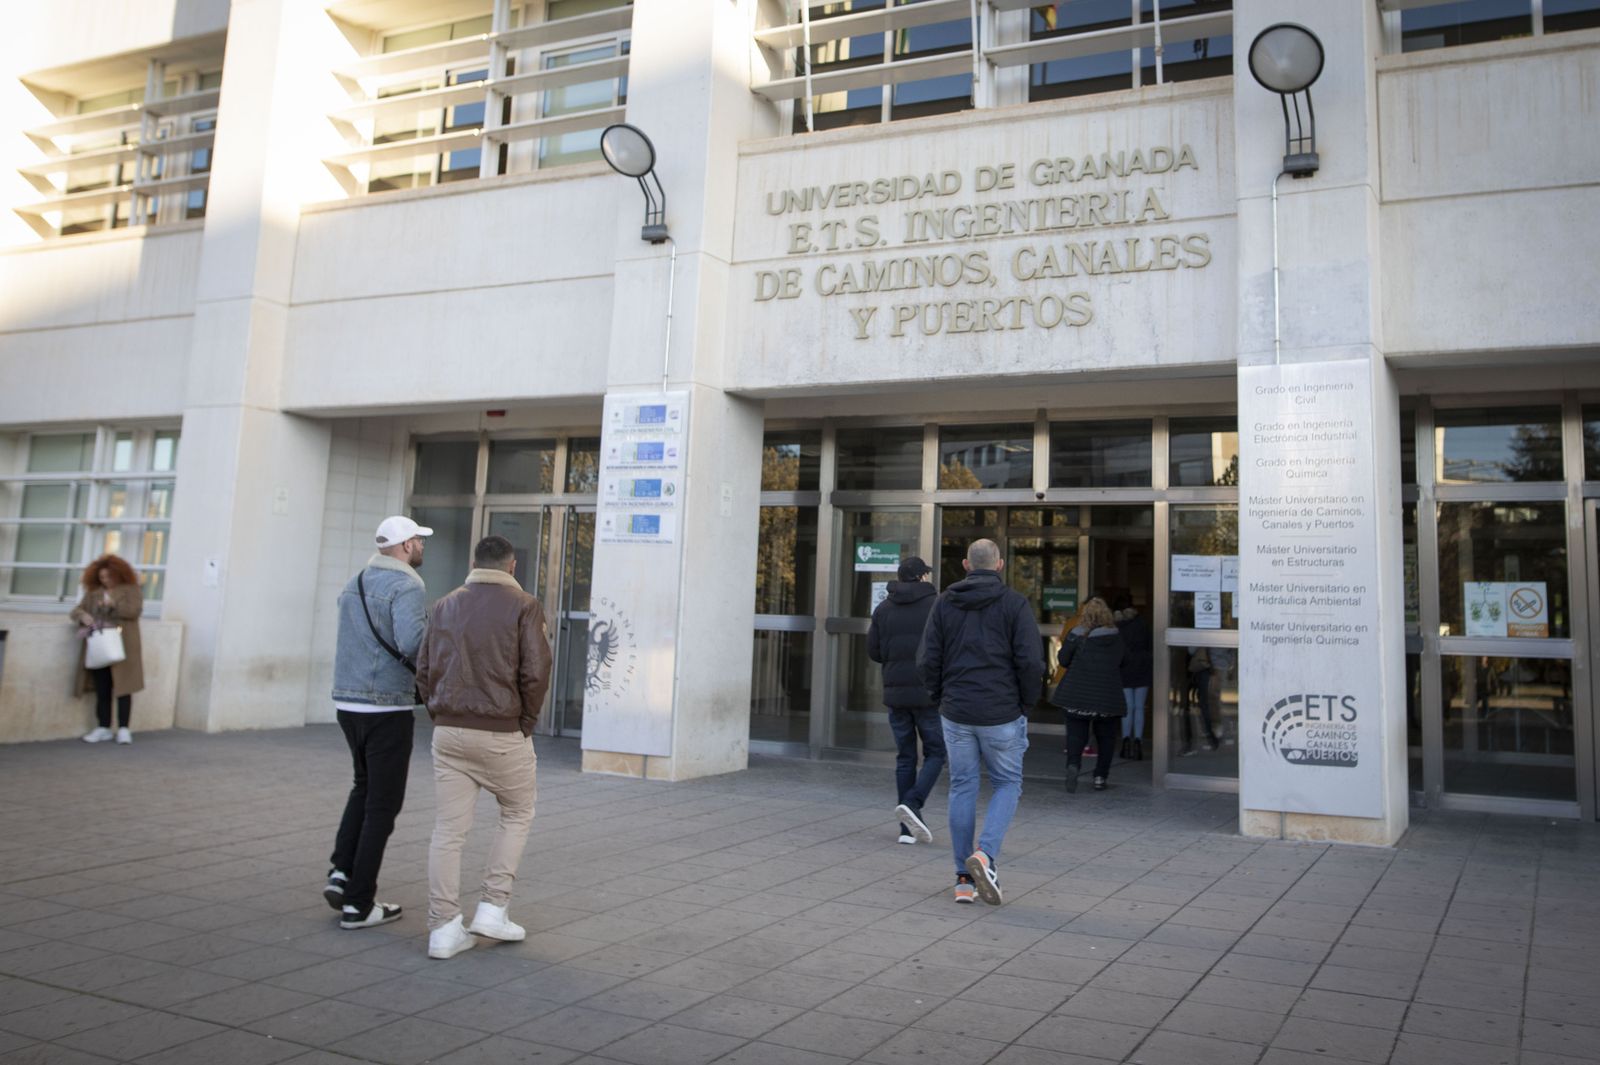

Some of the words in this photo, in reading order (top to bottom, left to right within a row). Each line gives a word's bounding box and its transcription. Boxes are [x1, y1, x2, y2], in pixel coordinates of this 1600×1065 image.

[766, 169, 962, 217] UNIVERSIDAD
[974, 162, 1016, 193] DE
[1028, 143, 1199, 187] GRANADA
[787, 215, 888, 254] E.T.S.
[903, 187, 1170, 243] INGENIERIA
[753, 268, 803, 302] DE
[814, 249, 997, 297] CAMINOS,
[1011, 232, 1212, 281] CANALES
[849, 306, 879, 340] Y
[890, 290, 1093, 338] PUERTOS
[1255, 384, 1286, 395] Grado
[1288, 385, 1301, 393] en
[1295, 395, 1317, 405] Civil
[1254, 421, 1285, 432] Grado
[1287, 422, 1300, 430] en
[1253, 433, 1308, 444] Electrónica
[1311, 431, 1358, 441] Industrial
[1255, 457, 1286, 468] Grado
[1289, 458, 1302, 466] en
[1248, 495, 1282, 505] Máster
[1285, 494, 1349, 505] Universitario
[1351, 495, 1365, 503] en
[1248, 506, 1298, 519] Ingeniería
[1300, 506, 1313, 517] de
[1316, 506, 1365, 517] Caminos,
[1261, 519, 1303, 529] Canales
[1305, 521, 1312, 531] y
[1314, 519, 1355, 529] Puertos
[1256, 544, 1291, 555] Máster
[1293, 544, 1357, 555] Universitario
[1271, 558, 1284, 567] en
[1287, 557, 1345, 568] Estructuras
[1249, 582, 1284, 593] Máster
[1286, 582, 1350, 594] Universitario
[1352, 585, 1366, 594] en
[1257, 595, 1308, 606] Hidráulica
[1309, 595, 1362, 607] Ambiental
[1250, 621, 1285, 632] Máster
[1287, 621, 1352, 633] Universitario
[1354, 623, 1368, 632] en
[1261, 633, 1313, 646] Ingeniería
[1305, 694, 1357, 722] ETS
[1305, 729, 1358, 741] CAMINOS
[1306, 740, 1349, 750] CANALES
[1350, 741, 1358, 750] Y
[1305, 749, 1358, 761] PUERTOS
